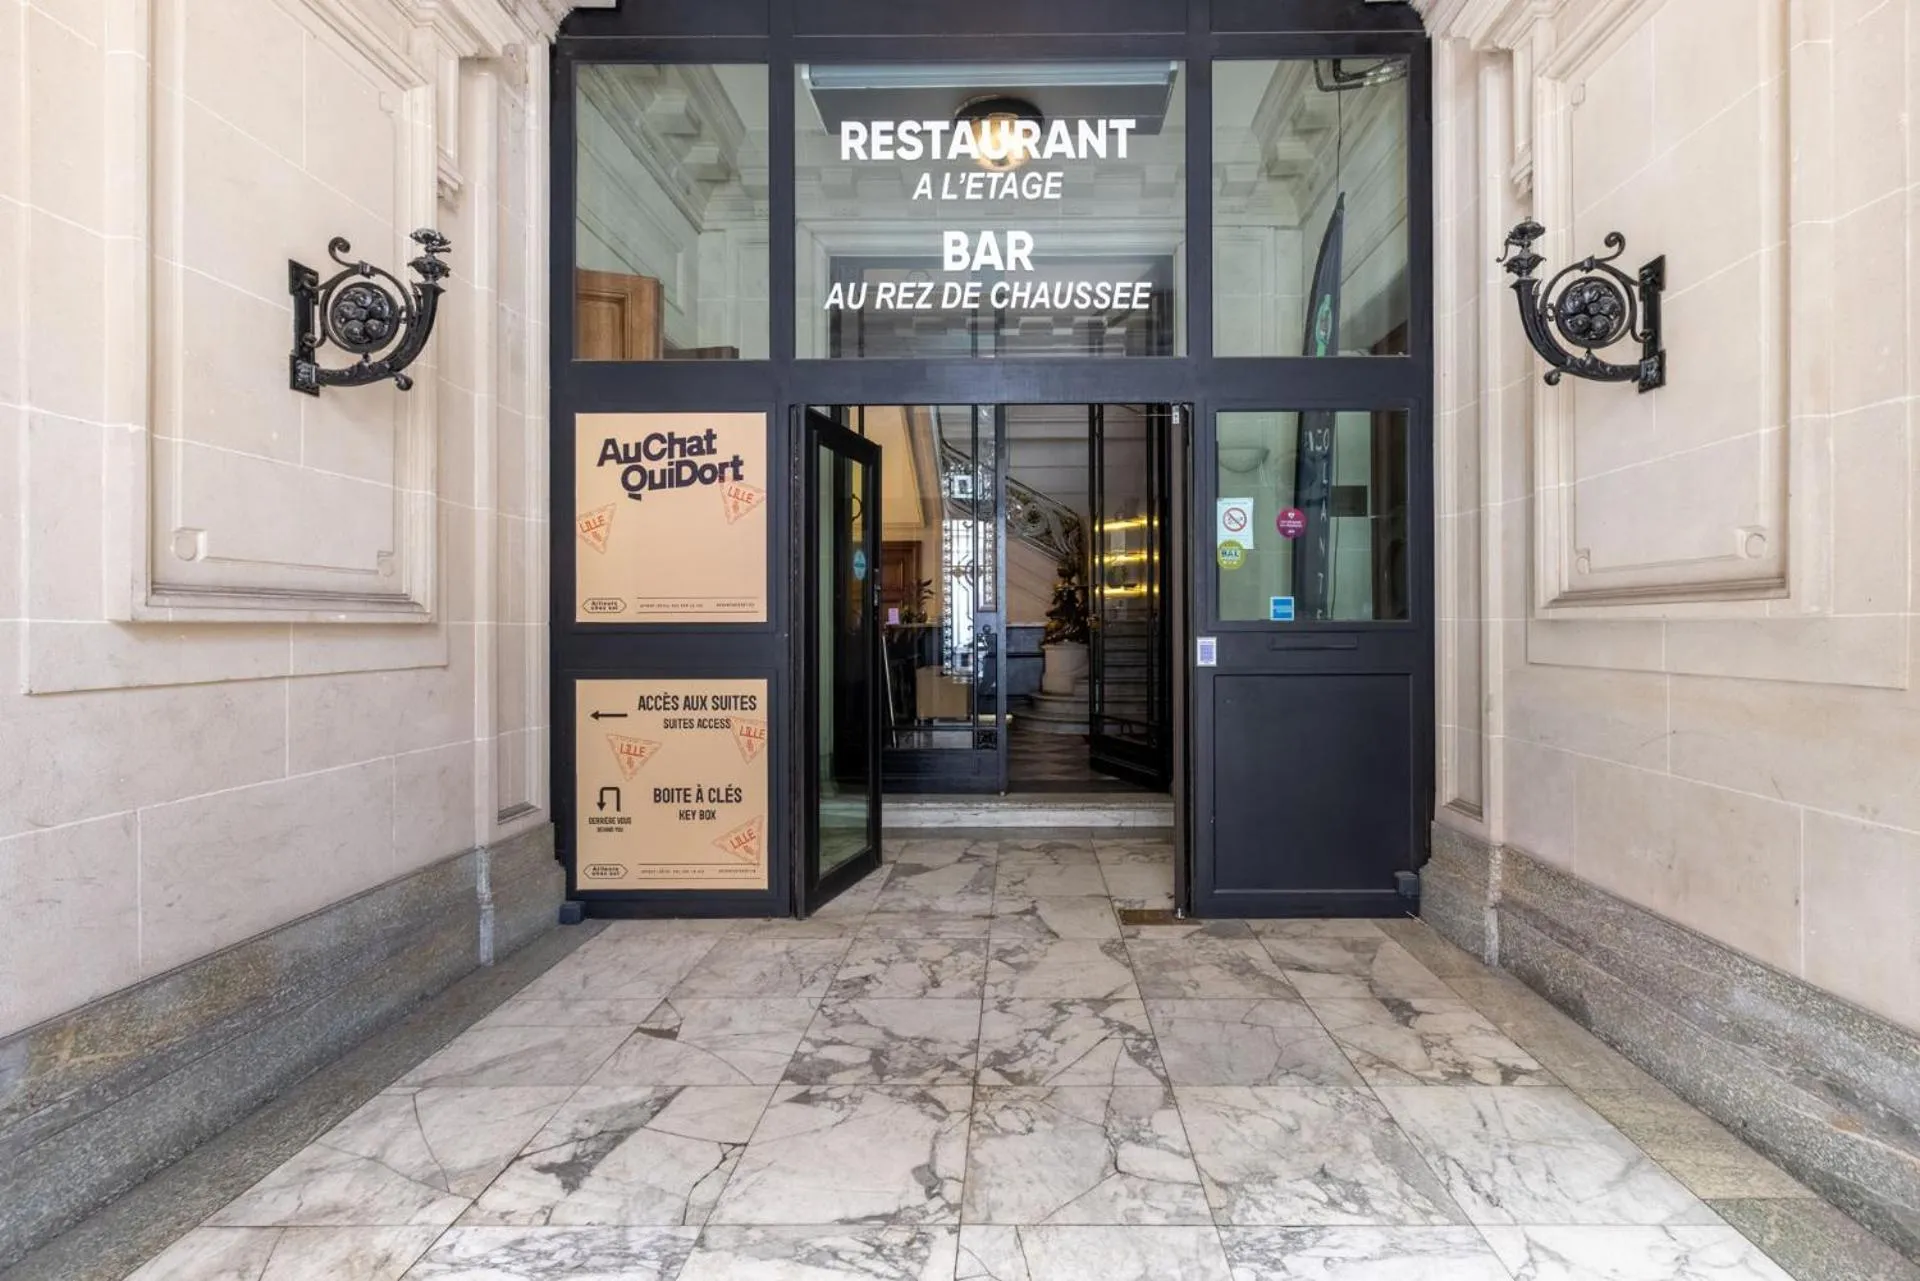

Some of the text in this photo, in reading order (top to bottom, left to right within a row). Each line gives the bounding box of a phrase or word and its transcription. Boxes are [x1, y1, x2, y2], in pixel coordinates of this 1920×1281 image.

[841, 119, 1137, 161] RESTAURANT
[912, 172, 934, 201] A
[943, 230, 1035, 272] BAR
[824, 280, 1153, 311] AU REZ DE CHAUSSEE
[597, 428, 718, 467] AuChat
[621, 455, 745, 502] QuiDort
[637, 691, 757, 712] ACCÈS AUX SUITES
[663, 717, 732, 730] SUITES ACCESS
[653, 783, 743, 804] BOITE À CLÉS
[678, 809, 717, 821] KEY BOX
